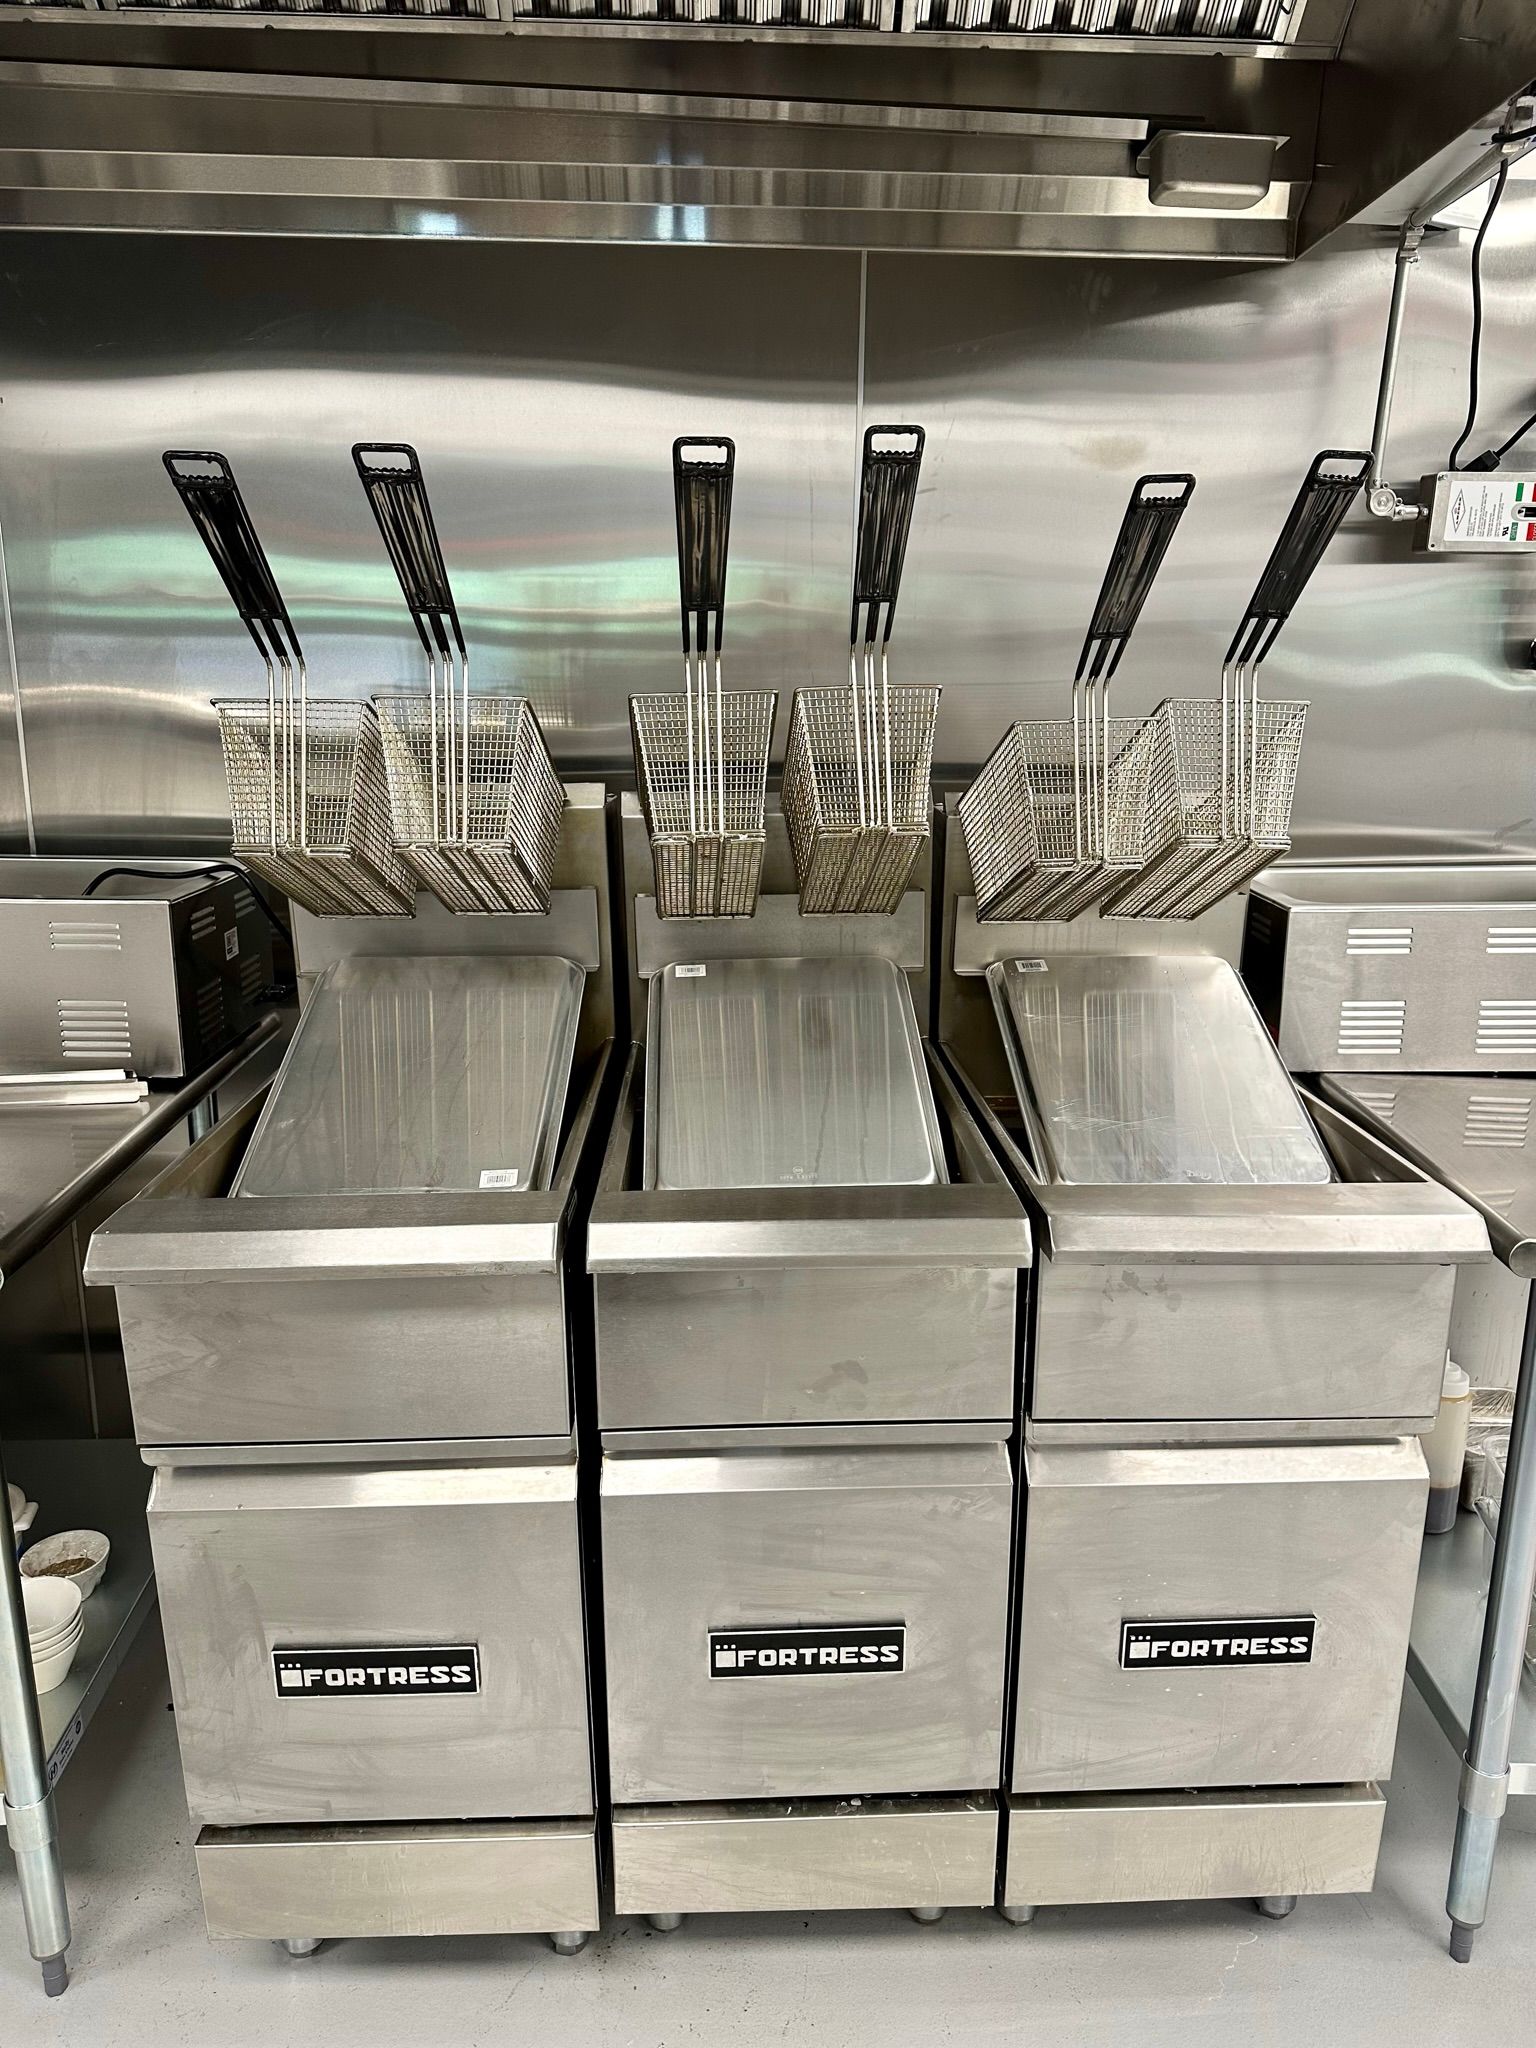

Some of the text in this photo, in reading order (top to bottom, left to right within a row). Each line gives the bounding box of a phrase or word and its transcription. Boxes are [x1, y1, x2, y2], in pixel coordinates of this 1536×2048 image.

[738, 1645, 899, 1667] FORTRESS
[1150, 1636, 1309, 1659] FORTRESS
[303, 1665, 471, 1687] FORTRESS
